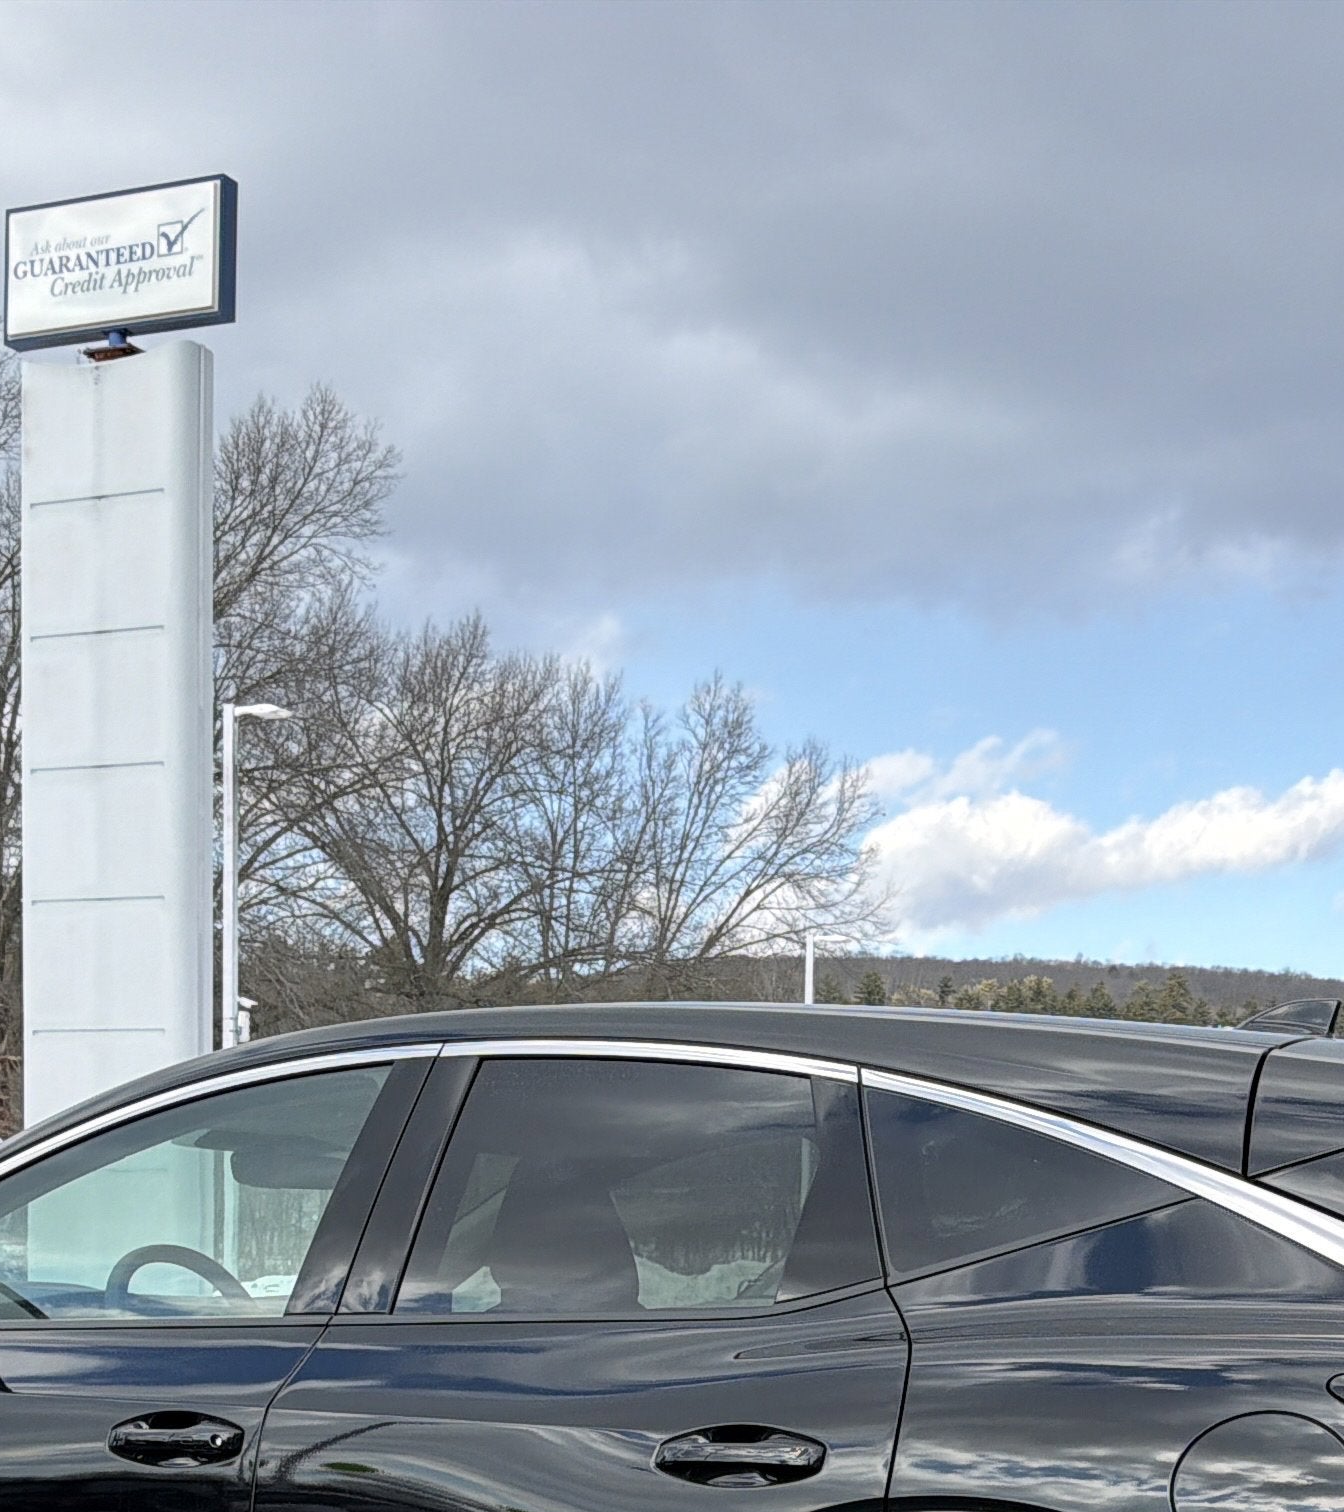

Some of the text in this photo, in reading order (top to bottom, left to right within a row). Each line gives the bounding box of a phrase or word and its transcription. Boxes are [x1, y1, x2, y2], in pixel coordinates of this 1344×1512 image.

[13, 241, 155, 279] GUARANTEED
[30, 233, 111, 256] Ask about our
[50, 256, 196, 297] Credit Approval
